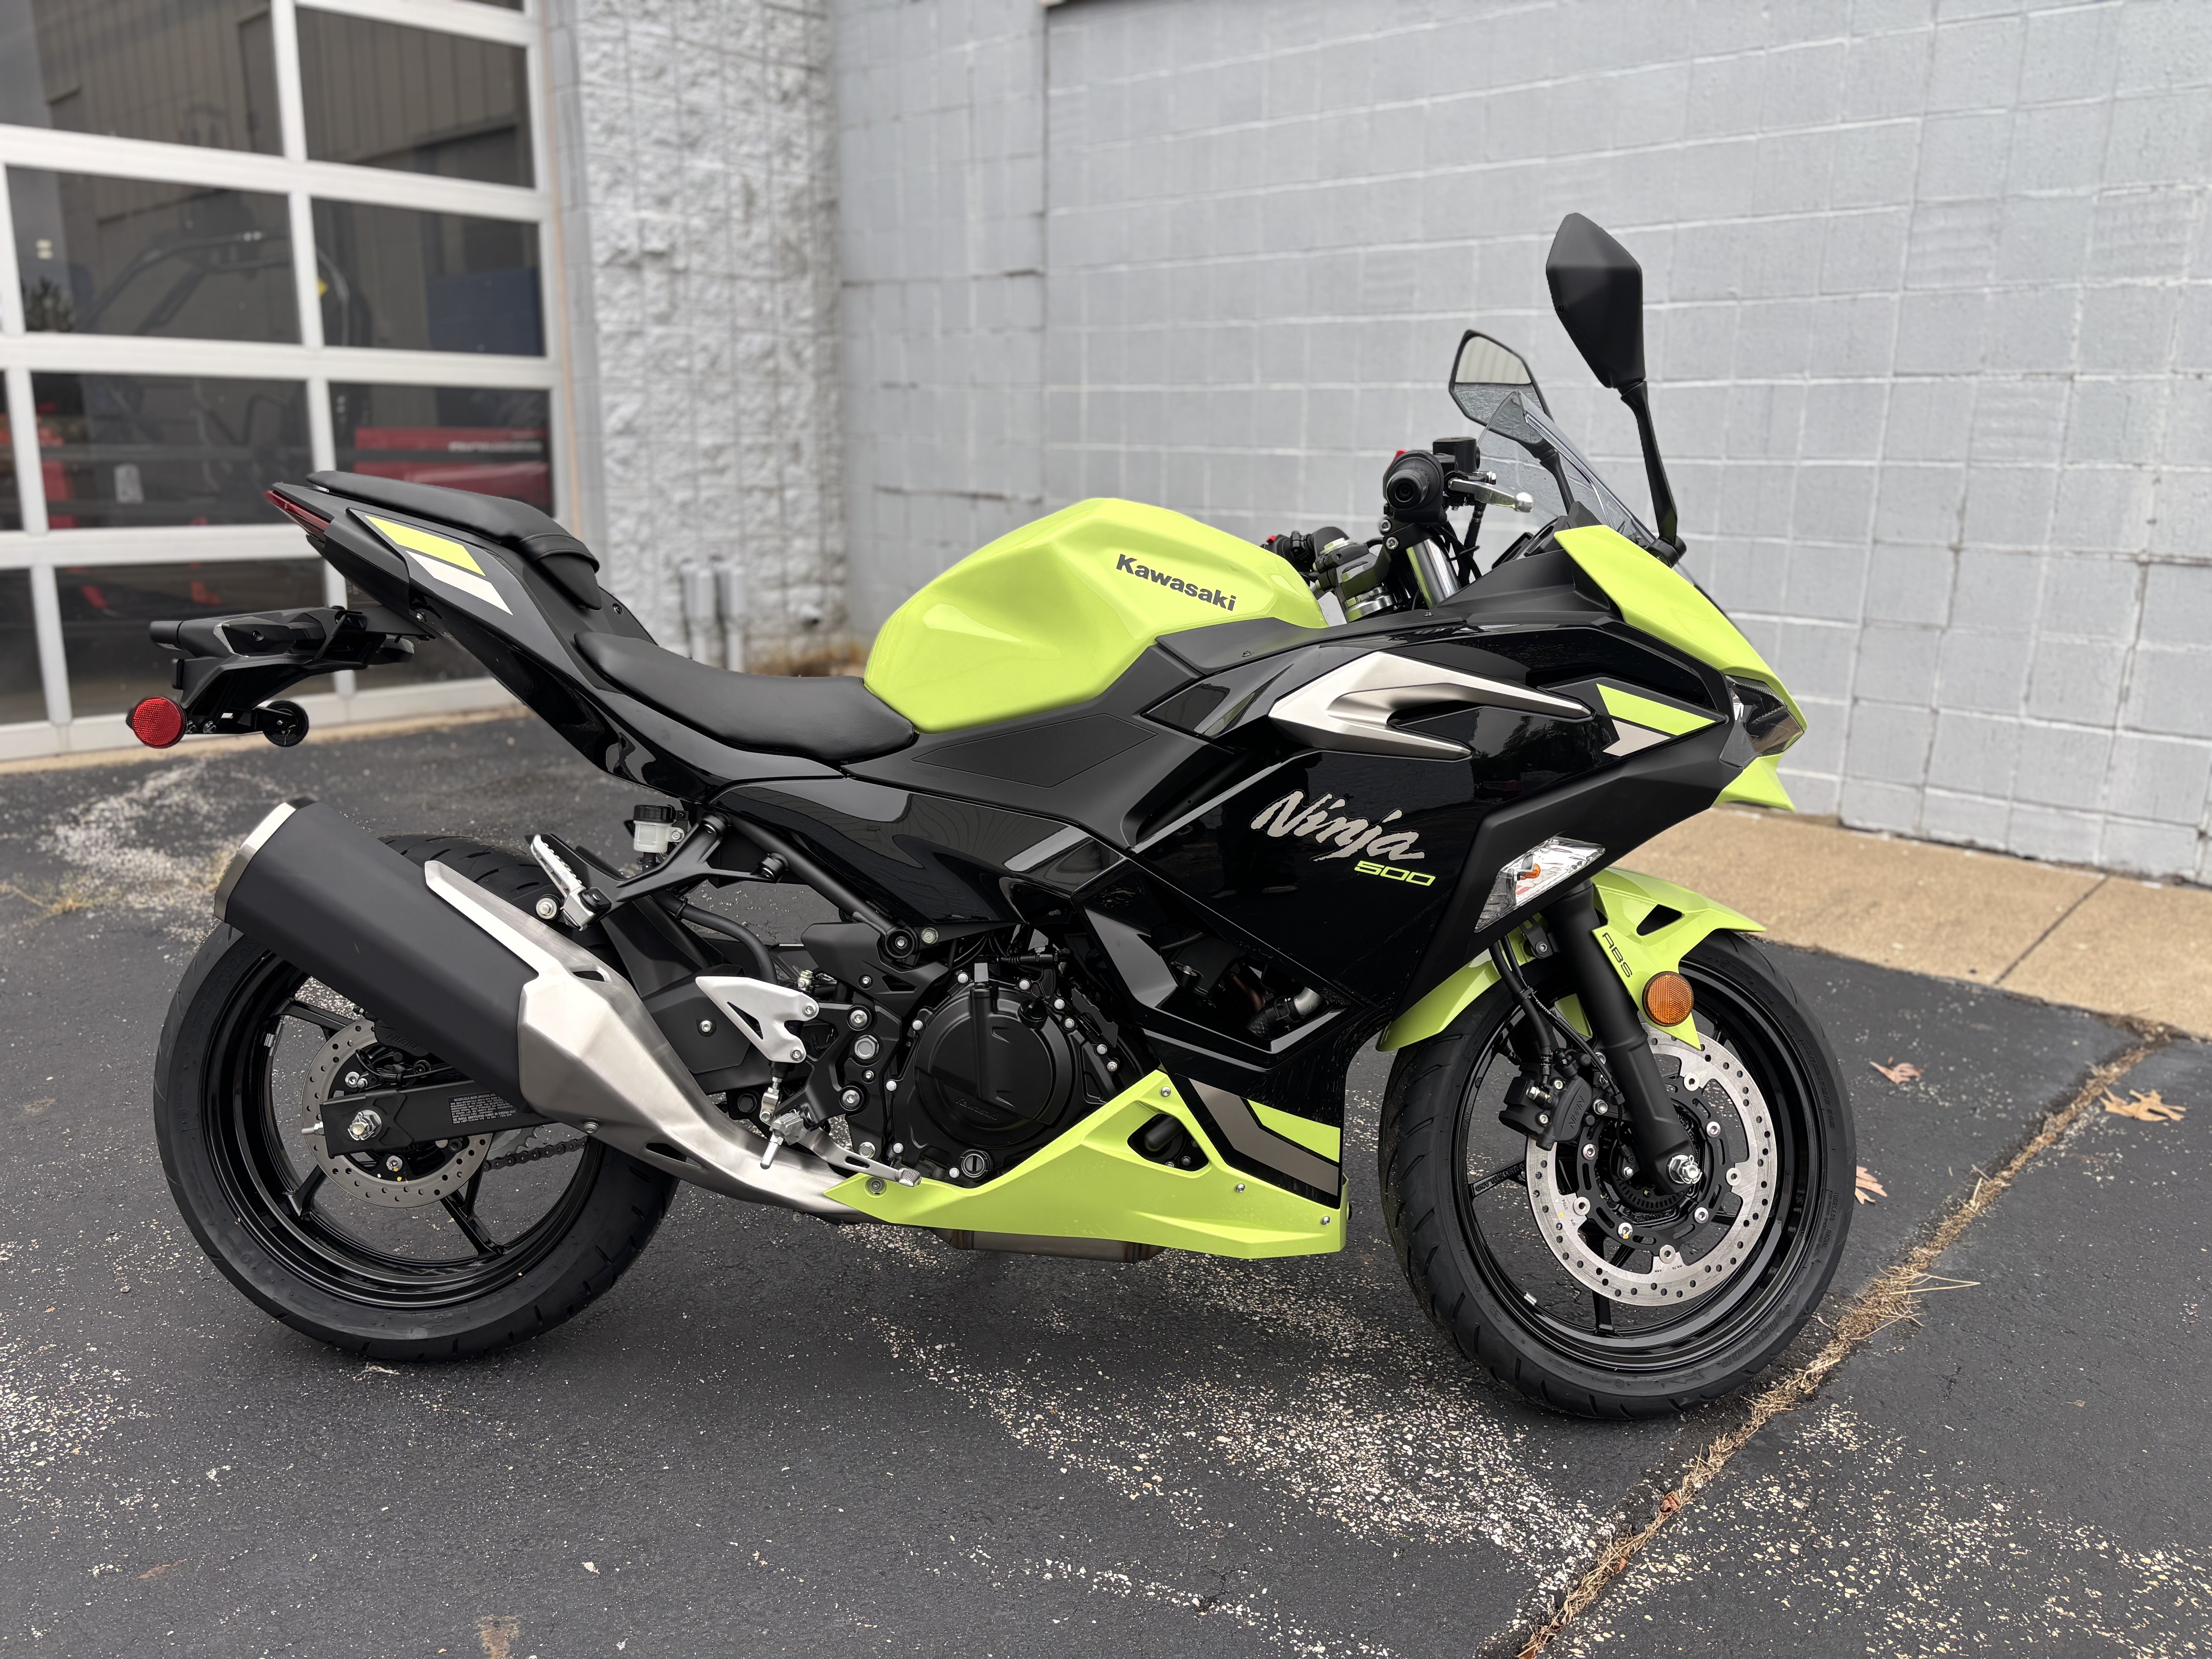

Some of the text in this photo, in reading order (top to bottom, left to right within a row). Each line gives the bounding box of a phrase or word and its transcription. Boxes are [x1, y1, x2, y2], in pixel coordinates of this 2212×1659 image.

[1116, 553, 1236, 611] Kawasaki
[1250, 790, 1425, 862] Ninja
[1354, 860, 1436, 886] 500
[1602, 932, 1633, 978] ABS
[1821, 1192, 1839, 1250] TUBELESS RADIAL
